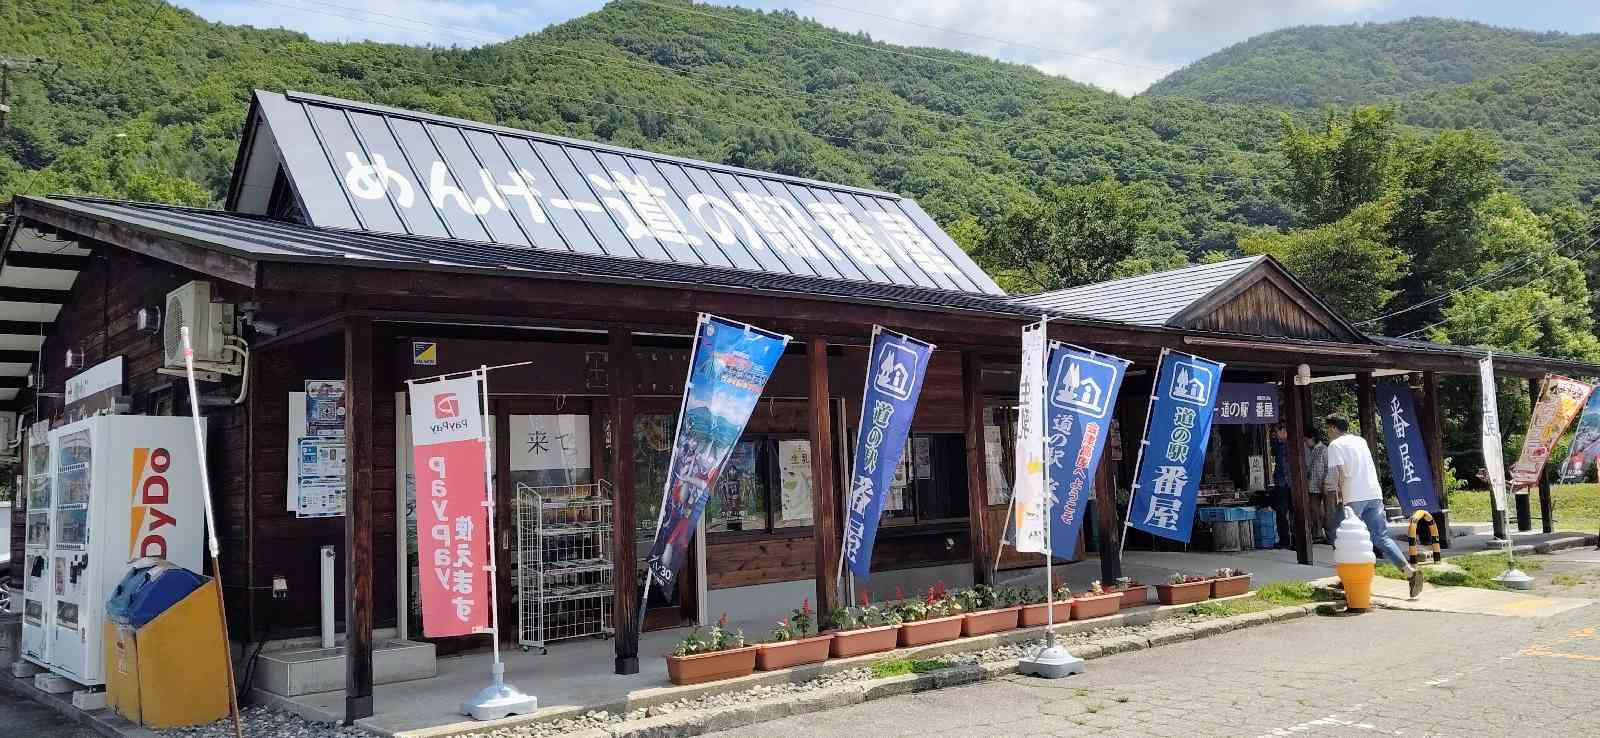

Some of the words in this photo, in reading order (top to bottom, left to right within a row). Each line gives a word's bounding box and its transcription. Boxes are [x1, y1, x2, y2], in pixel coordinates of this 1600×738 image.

[345, 151, 961, 275] めんげー道の駅番屋
[1166, 406, 1196, 464] 道の駅
[1390, 394, 1422, 484] 番屋
[141, 448, 177, 561] DyDo
[1143, 465, 1191, 531] 番屋
